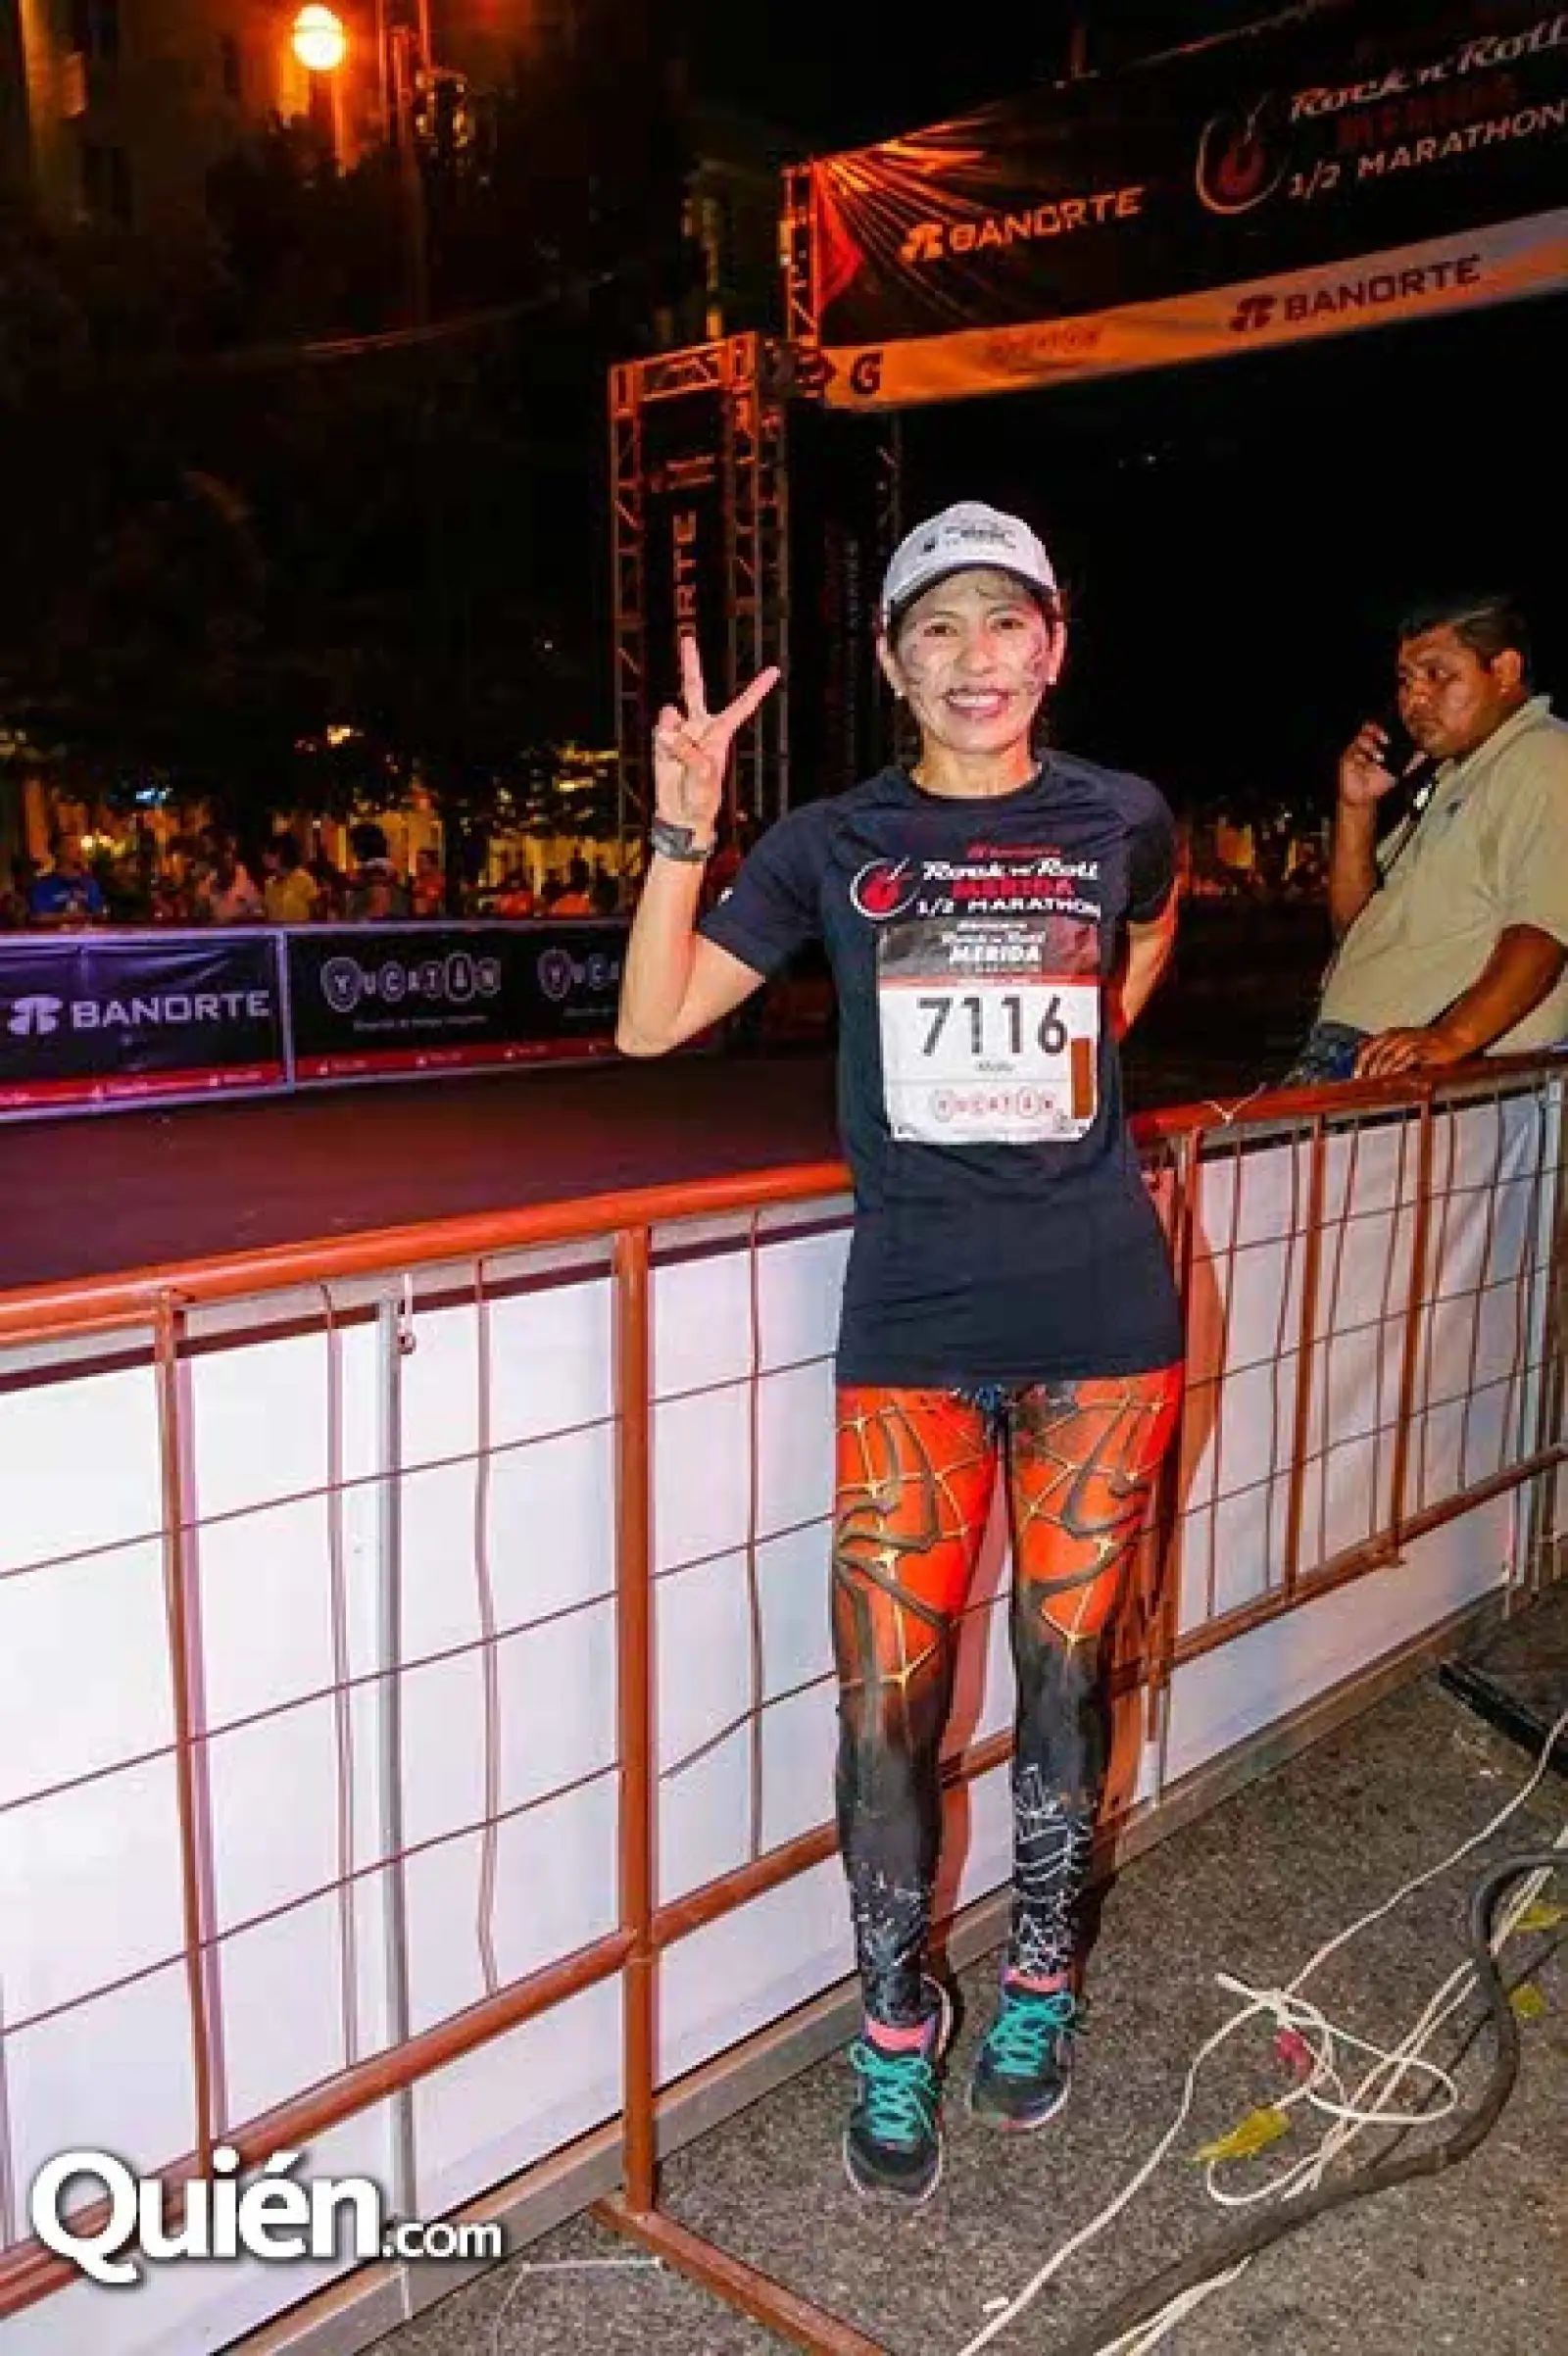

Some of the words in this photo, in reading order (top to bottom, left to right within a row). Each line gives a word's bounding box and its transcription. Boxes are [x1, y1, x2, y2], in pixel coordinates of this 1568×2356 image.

[1287, 159, 1343, 201] 1/2
[1354, 98, 1568, 180] MARATHON
[948, 186, 1146, 255] BANORTE
[1283, 254, 1481, 323] BANORTE
[71, 989, 271, 1031] BANORTE
[916, 993, 1069, 1057] 7116
